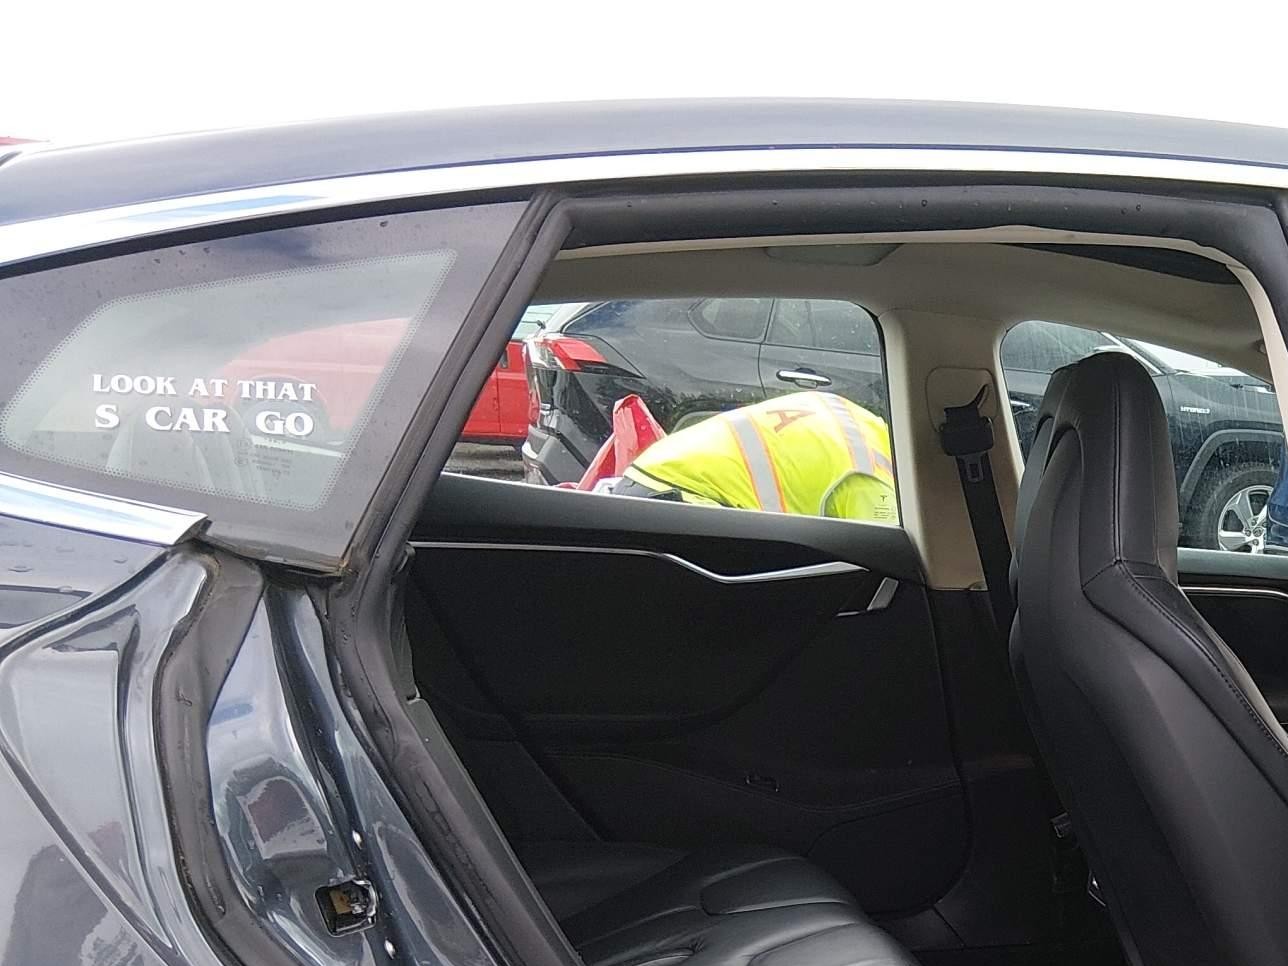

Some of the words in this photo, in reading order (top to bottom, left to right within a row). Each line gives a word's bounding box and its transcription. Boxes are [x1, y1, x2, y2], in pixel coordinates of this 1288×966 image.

[93, 374, 177, 395] LOOK
[188, 378, 228, 397] AT
[237, 380, 316, 401] THAT
[95, 404, 120, 428] S
[145, 406, 230, 433] CAR
[255, 410, 314, 436] GO
